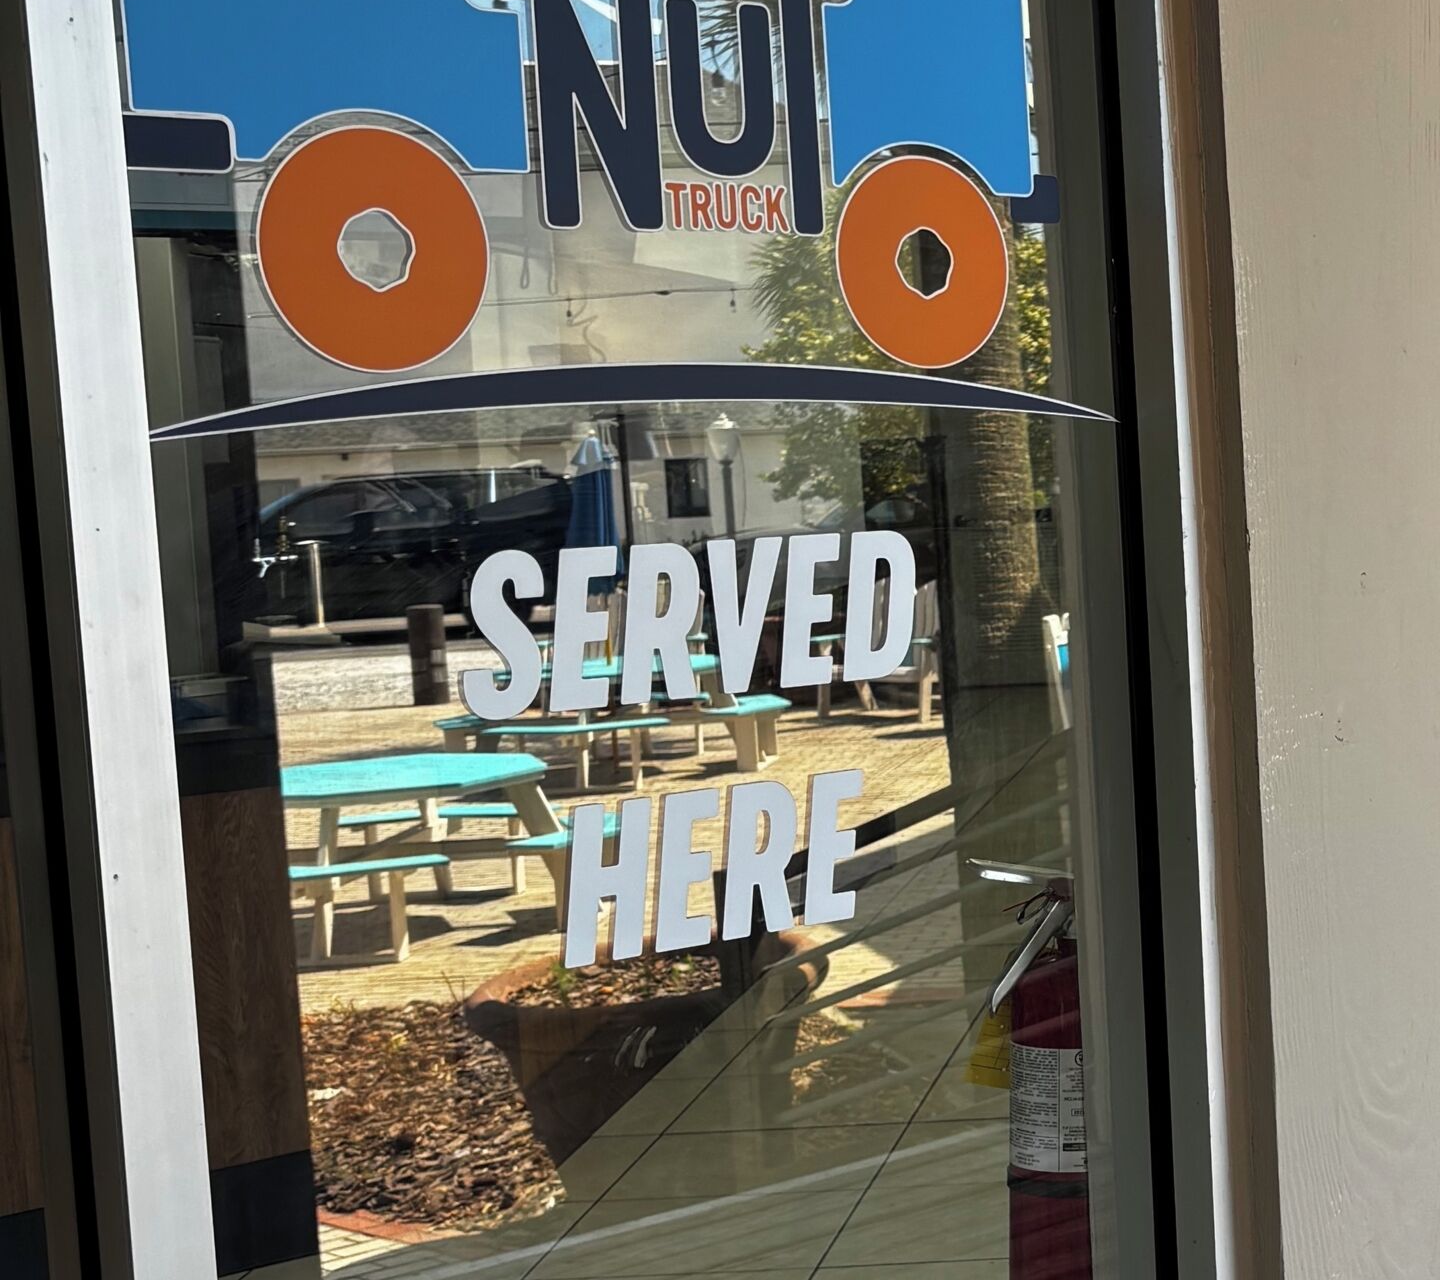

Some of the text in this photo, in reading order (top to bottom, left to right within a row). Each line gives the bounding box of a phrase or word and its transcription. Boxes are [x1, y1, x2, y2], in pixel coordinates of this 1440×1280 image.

[663, 180, 791, 234] TRUCK
[458, 530, 917, 721] SERVED
[564, 768, 864, 970] HERE
